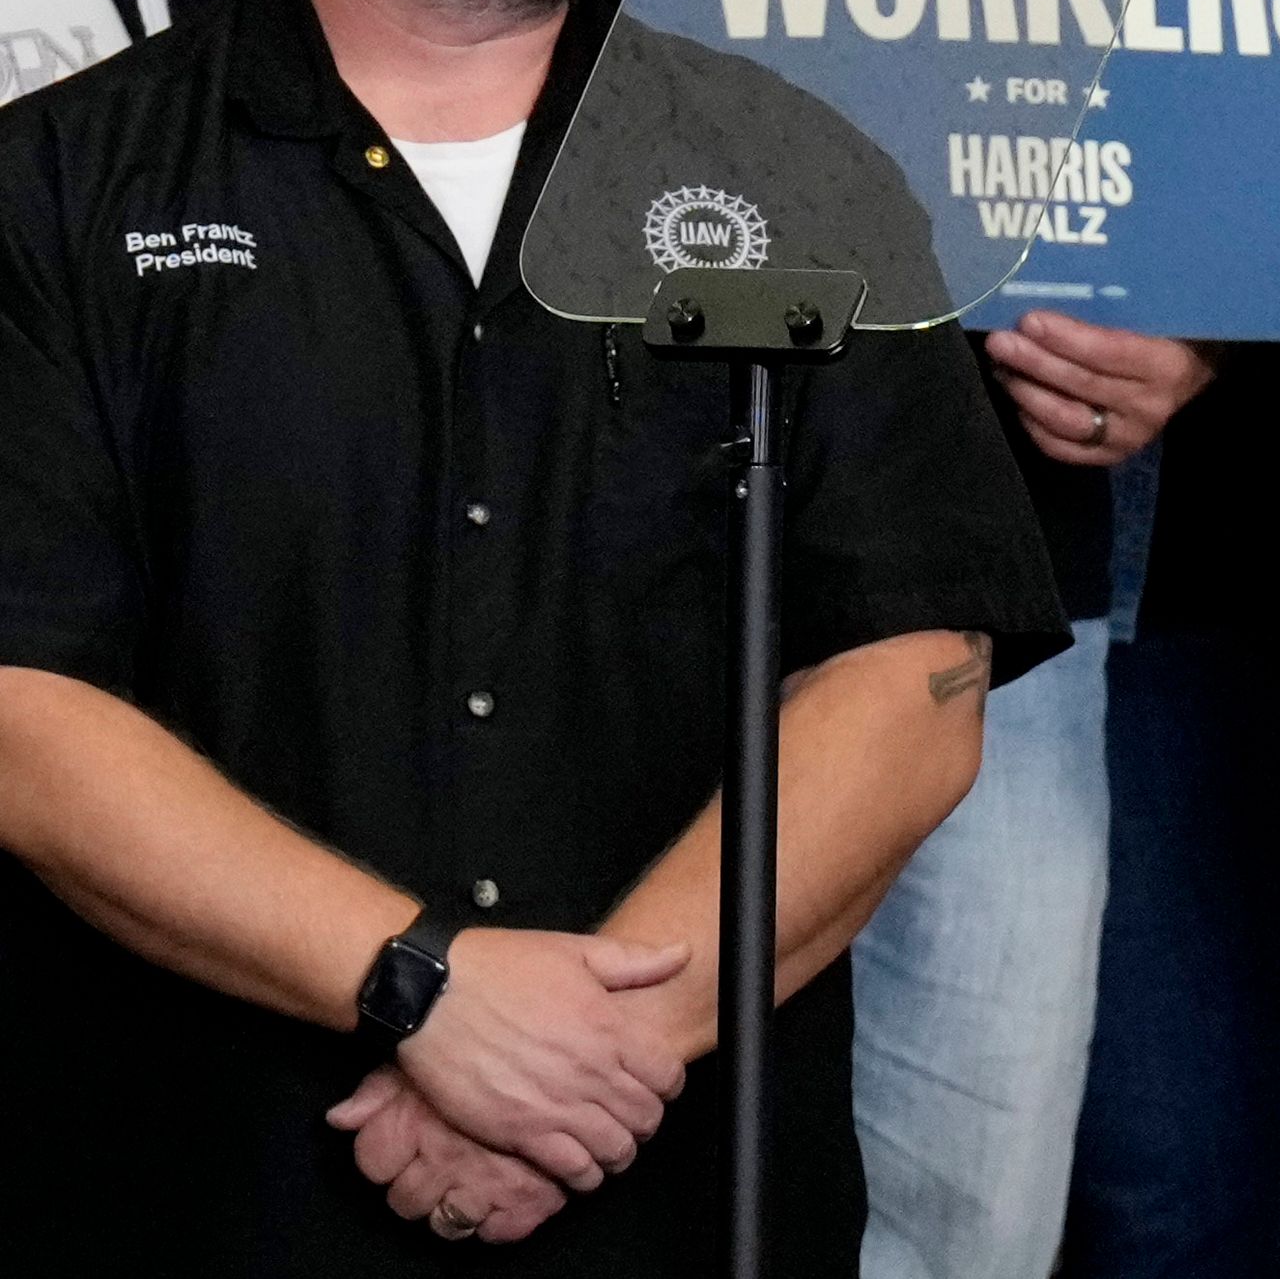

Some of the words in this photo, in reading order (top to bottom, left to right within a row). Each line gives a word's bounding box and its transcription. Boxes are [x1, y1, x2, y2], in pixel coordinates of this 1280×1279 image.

[1006, 77, 1068, 105] FOR
[948, 132, 1133, 207] HARRIS
[125, 231, 177, 253] Ben
[181, 223, 257, 248] Frantz
[680, 221, 732, 247] UAW
[977, 200, 1108, 245] WALZ
[135, 242, 257, 277] President
